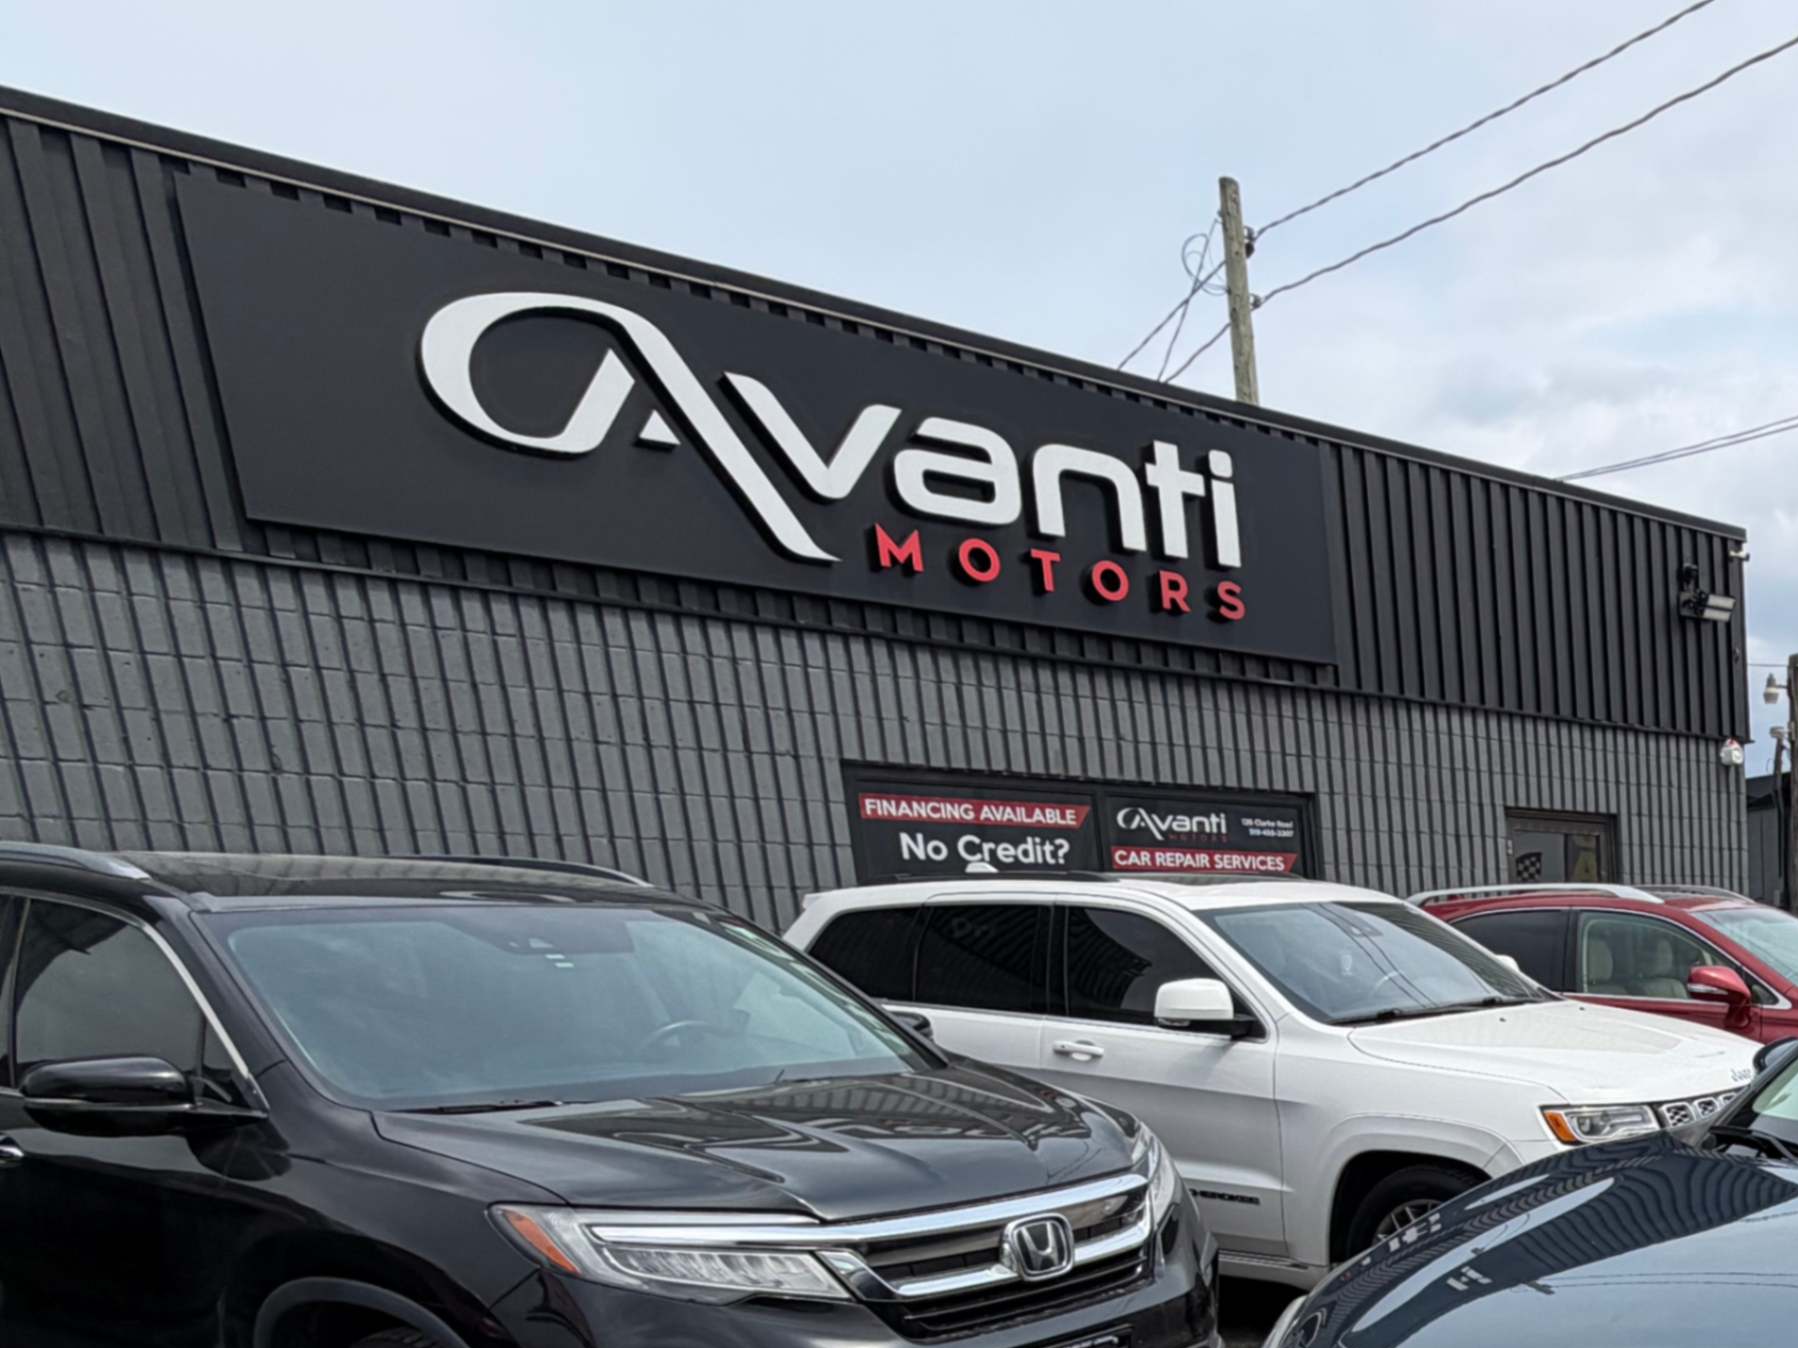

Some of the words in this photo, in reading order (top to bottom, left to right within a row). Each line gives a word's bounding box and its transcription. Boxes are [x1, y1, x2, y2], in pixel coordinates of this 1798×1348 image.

[420, 291, 1242, 568] Avanti
[874, 523, 1246, 620] MOTORS
[864, 798, 975, 820] FINANCING
[980, 805, 1077, 825] AVAILABLE
[1116, 807, 1228, 841] Avanti
[899, 832, 948, 861] No
[957, 834, 1070, 864] Credit?
[1114, 850, 1151, 866] CAR
[1155, 852, 1210, 868] REPAIR
[1213, 854, 1285, 871] SERVICES
